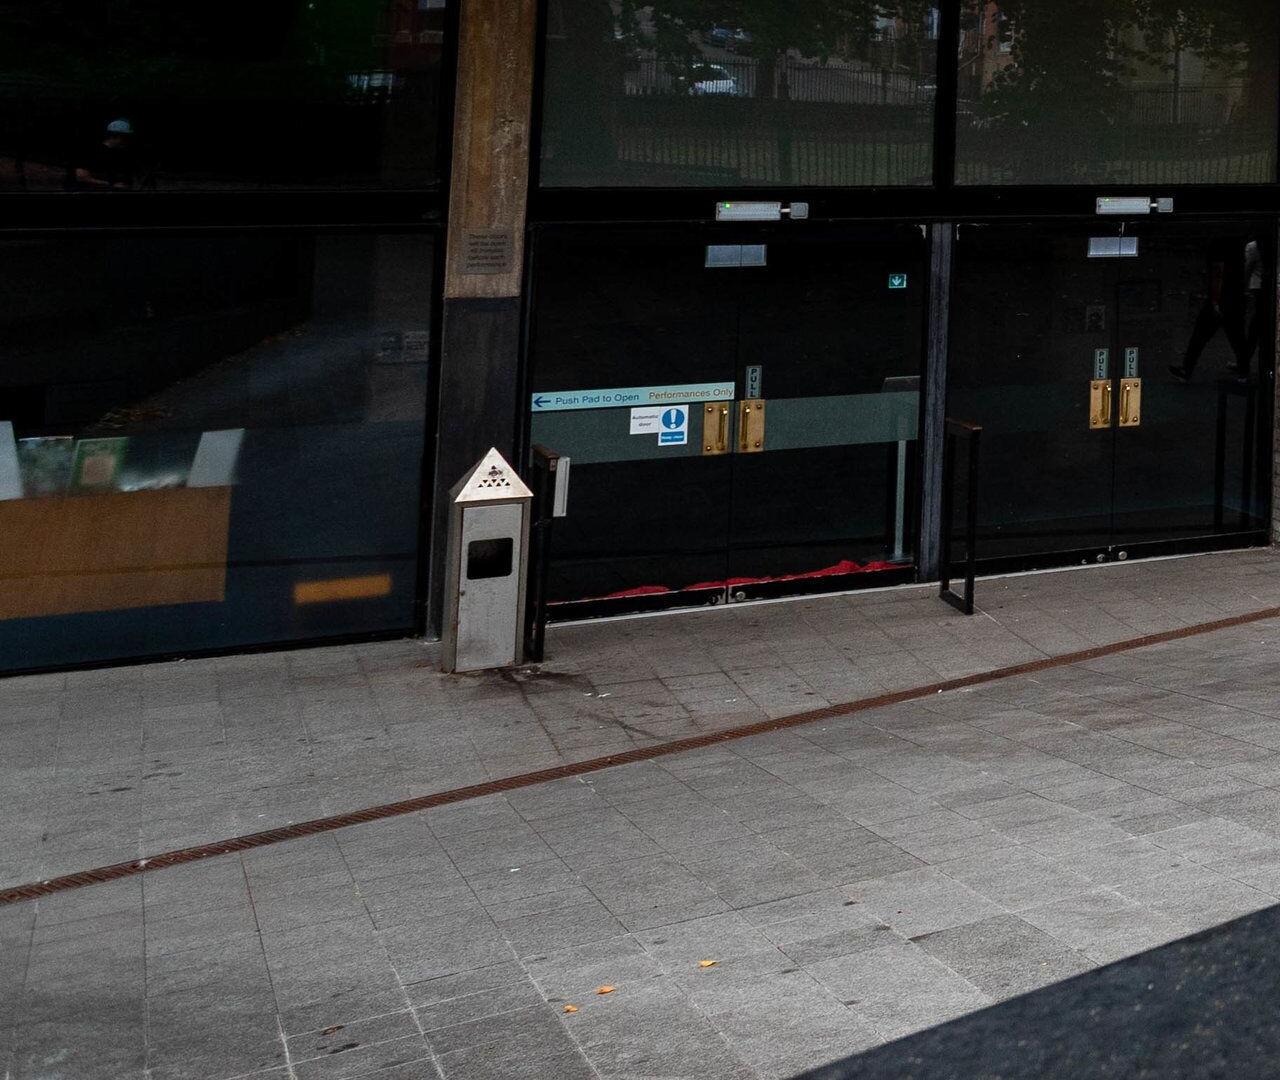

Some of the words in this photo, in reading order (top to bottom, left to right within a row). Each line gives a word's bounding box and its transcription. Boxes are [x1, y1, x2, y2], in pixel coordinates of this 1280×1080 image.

[750, 368, 758, 398] PULL
[555, 396, 580, 406] Push
[582, 394, 600, 404] Pad
[602, 394, 612, 403] to
[614, 392, 640, 404] Open
[648, 388, 711, 400] Performances
[713, 387, 734, 399] Only
